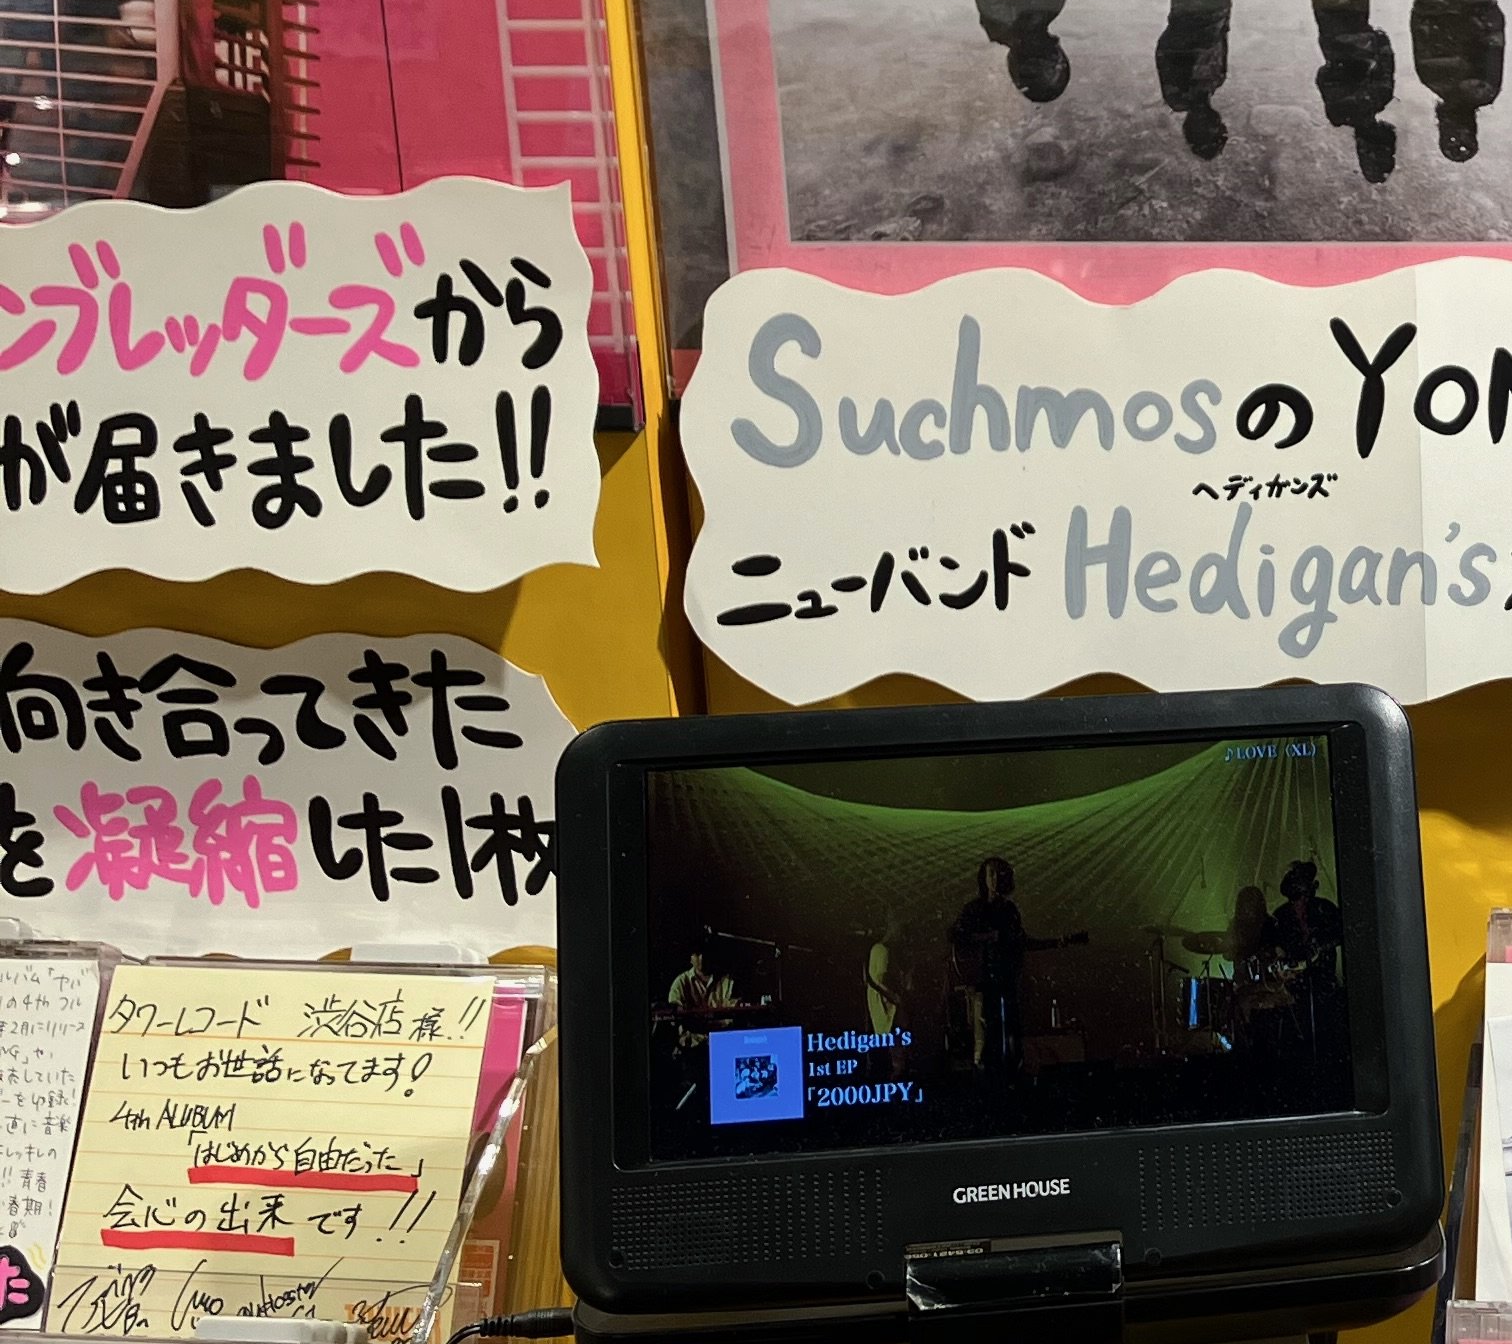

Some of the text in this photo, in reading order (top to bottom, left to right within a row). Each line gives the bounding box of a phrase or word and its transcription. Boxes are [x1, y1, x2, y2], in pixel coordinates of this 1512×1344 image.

[1192, 472, 1339, 500] ヘディガンズ
[717, 521, 1036, 626] ニューバンド
[1236, 744, 1277, 759] LOVE
[806, 1026, 912, 1053] Hedigan's
[809, 1059, 858, 1077] 1st EP
